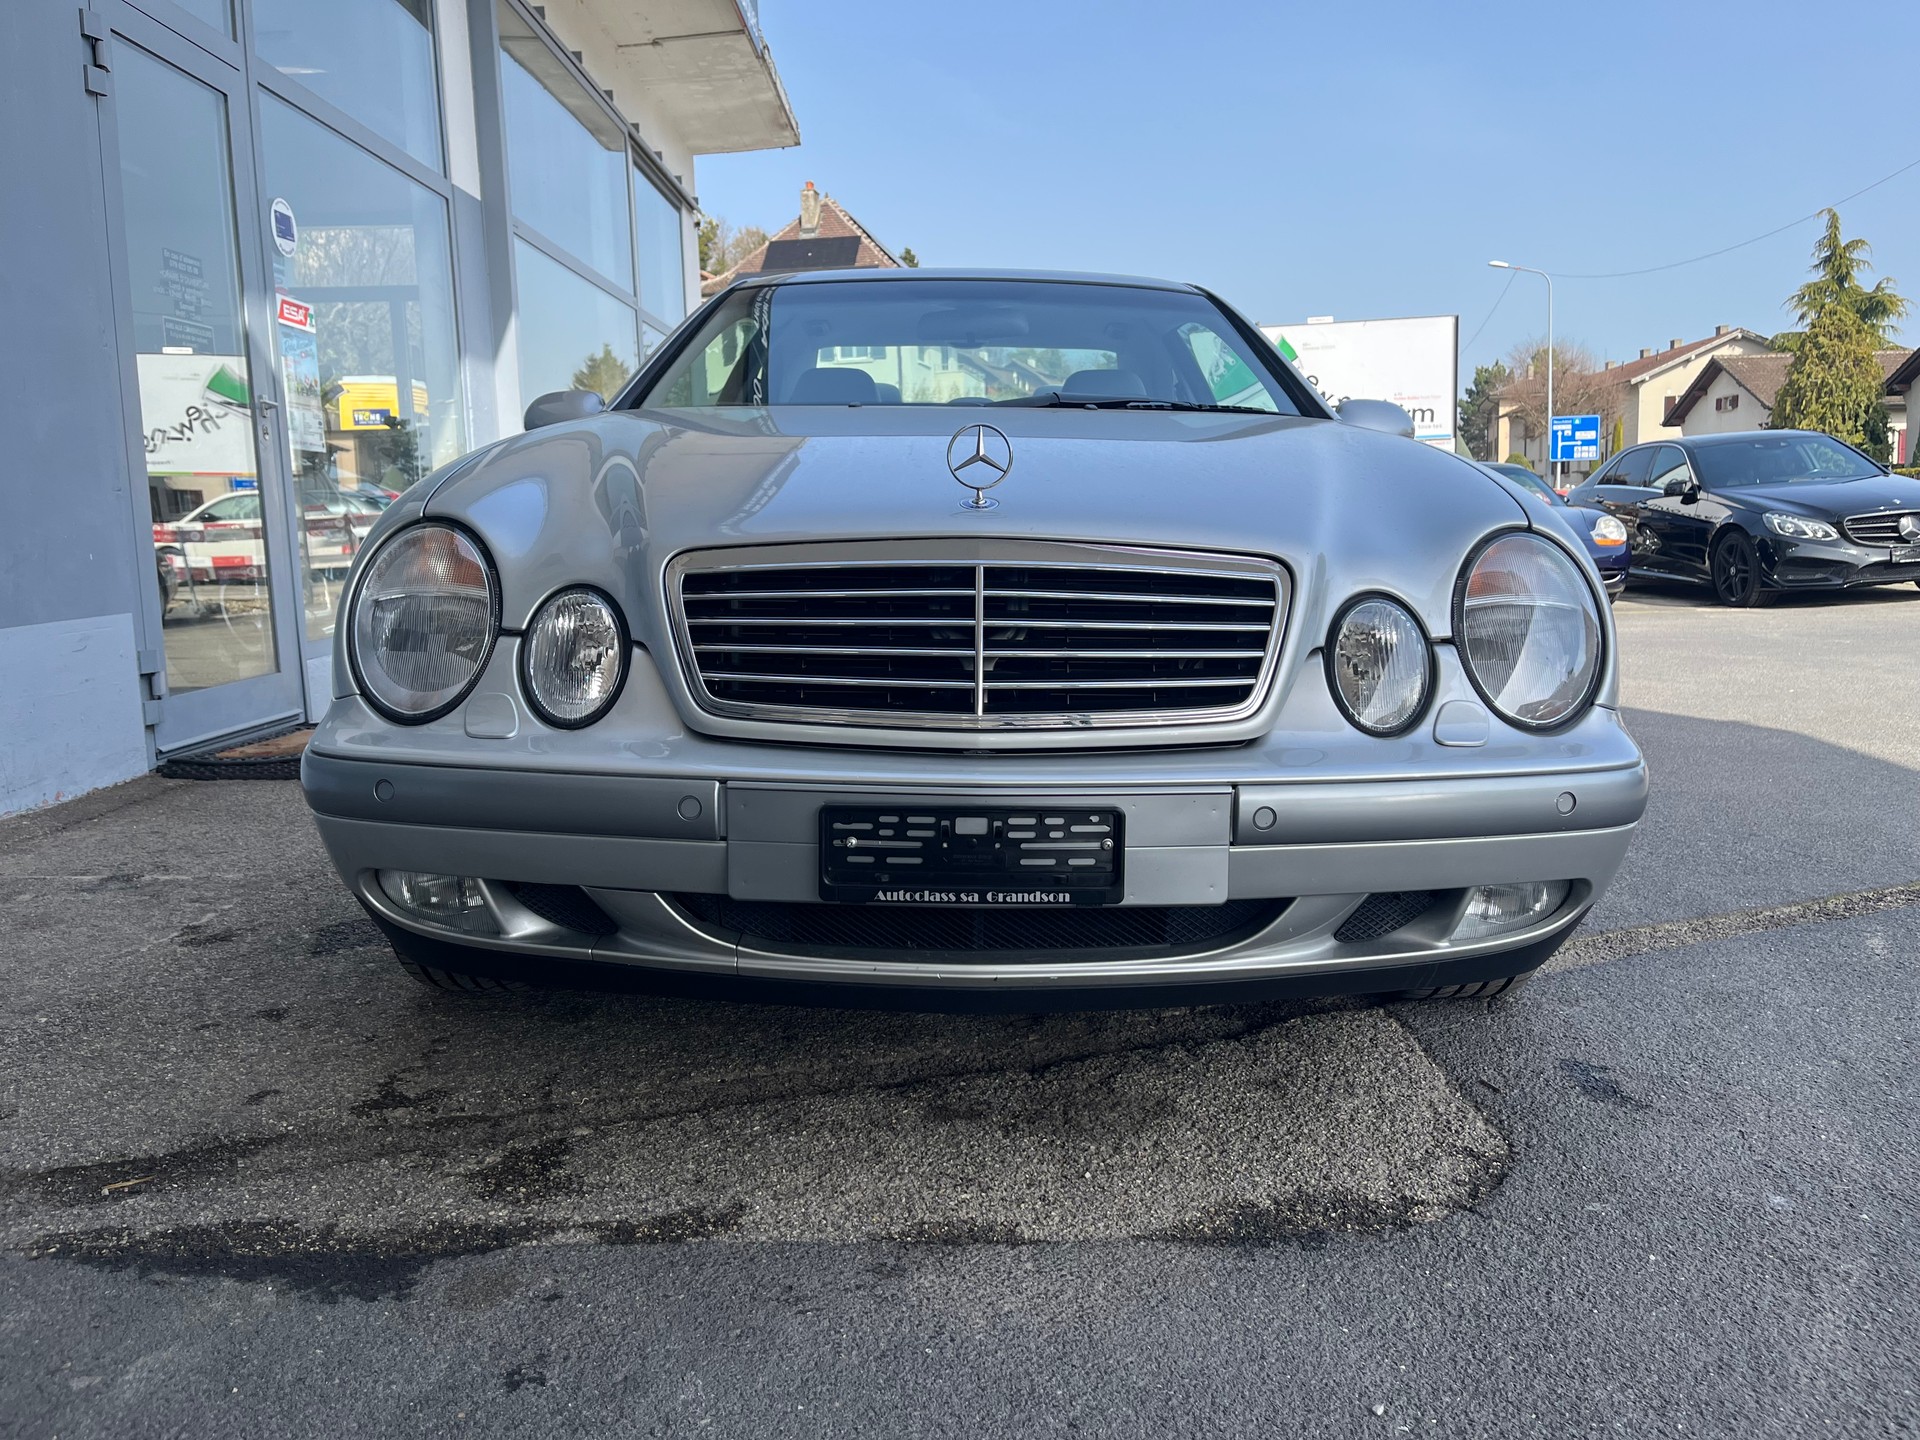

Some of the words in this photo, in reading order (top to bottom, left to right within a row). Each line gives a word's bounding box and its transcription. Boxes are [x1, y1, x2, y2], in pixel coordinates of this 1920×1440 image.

[282, 303, 305, 323] ESA
[874, 890, 956, 902] Autoclass
[959, 892, 979, 902] sa
[986, 891, 1070, 903] Grandson
